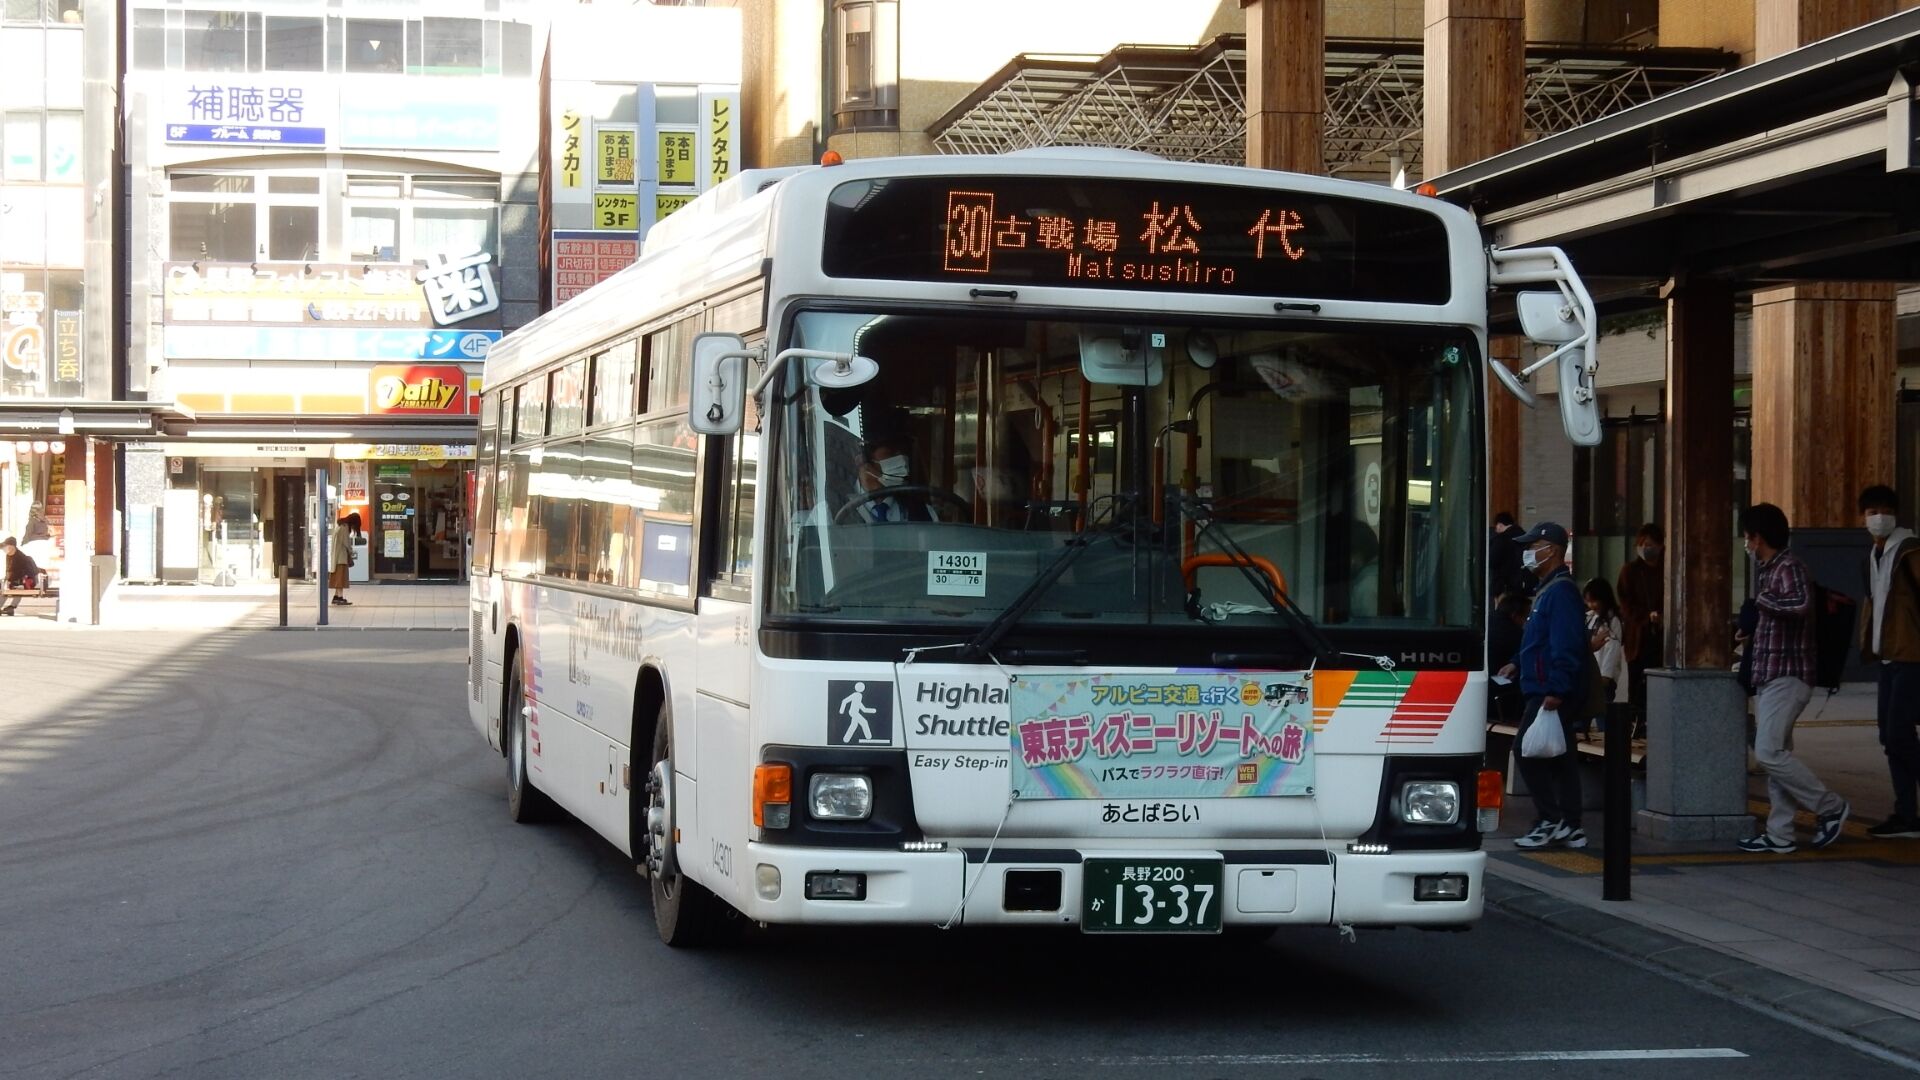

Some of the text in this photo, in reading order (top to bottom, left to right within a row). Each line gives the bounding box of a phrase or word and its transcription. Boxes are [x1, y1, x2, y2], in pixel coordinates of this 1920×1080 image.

[188, 84, 304, 122] 補聴器
[562, 107, 580, 187] ンタカー
[604, 134, 615, 178] あります
[617, 134, 630, 159] 本日
[665, 136, 676, 179] あります
[678, 136, 690, 161] 本日
[597, 198, 635, 209] レンタカー
[658, 198, 689, 209] レンタカ
[603, 211, 630, 227] 3F
[950, 203, 987, 259] 30
[994, 214, 1118, 253] 古戦場
[559, 258, 593, 270] JR切符
[1068, 253, 1236, 285] Matsushiro
[416, 242, 499, 326] 歯
[59, 317, 79, 379] 立ち呑
[463, 338, 487, 353] 4F
[375, 376, 460, 409] Daily
[400, 400, 438, 408] YAMAZAKI
[938, 554, 977, 568] 14301
[935, 574, 979, 585] 30 76
[1400, 651, 1462, 664] HINO
[1091, 683, 1239, 706] アルピコ交通で行く
[916, 714, 1010, 737] Shuttle
[1017, 709, 1307, 767] 東京ディズニーリゾートへの旅
[915, 754, 1008, 771] Easy Step-in
[1102, 803, 1200, 824] あとばらい
[711, 837, 733, 879] 14301
[1122, 866, 1185, 882] 長野200
[1091, 884, 1214, 925] か 13-37
